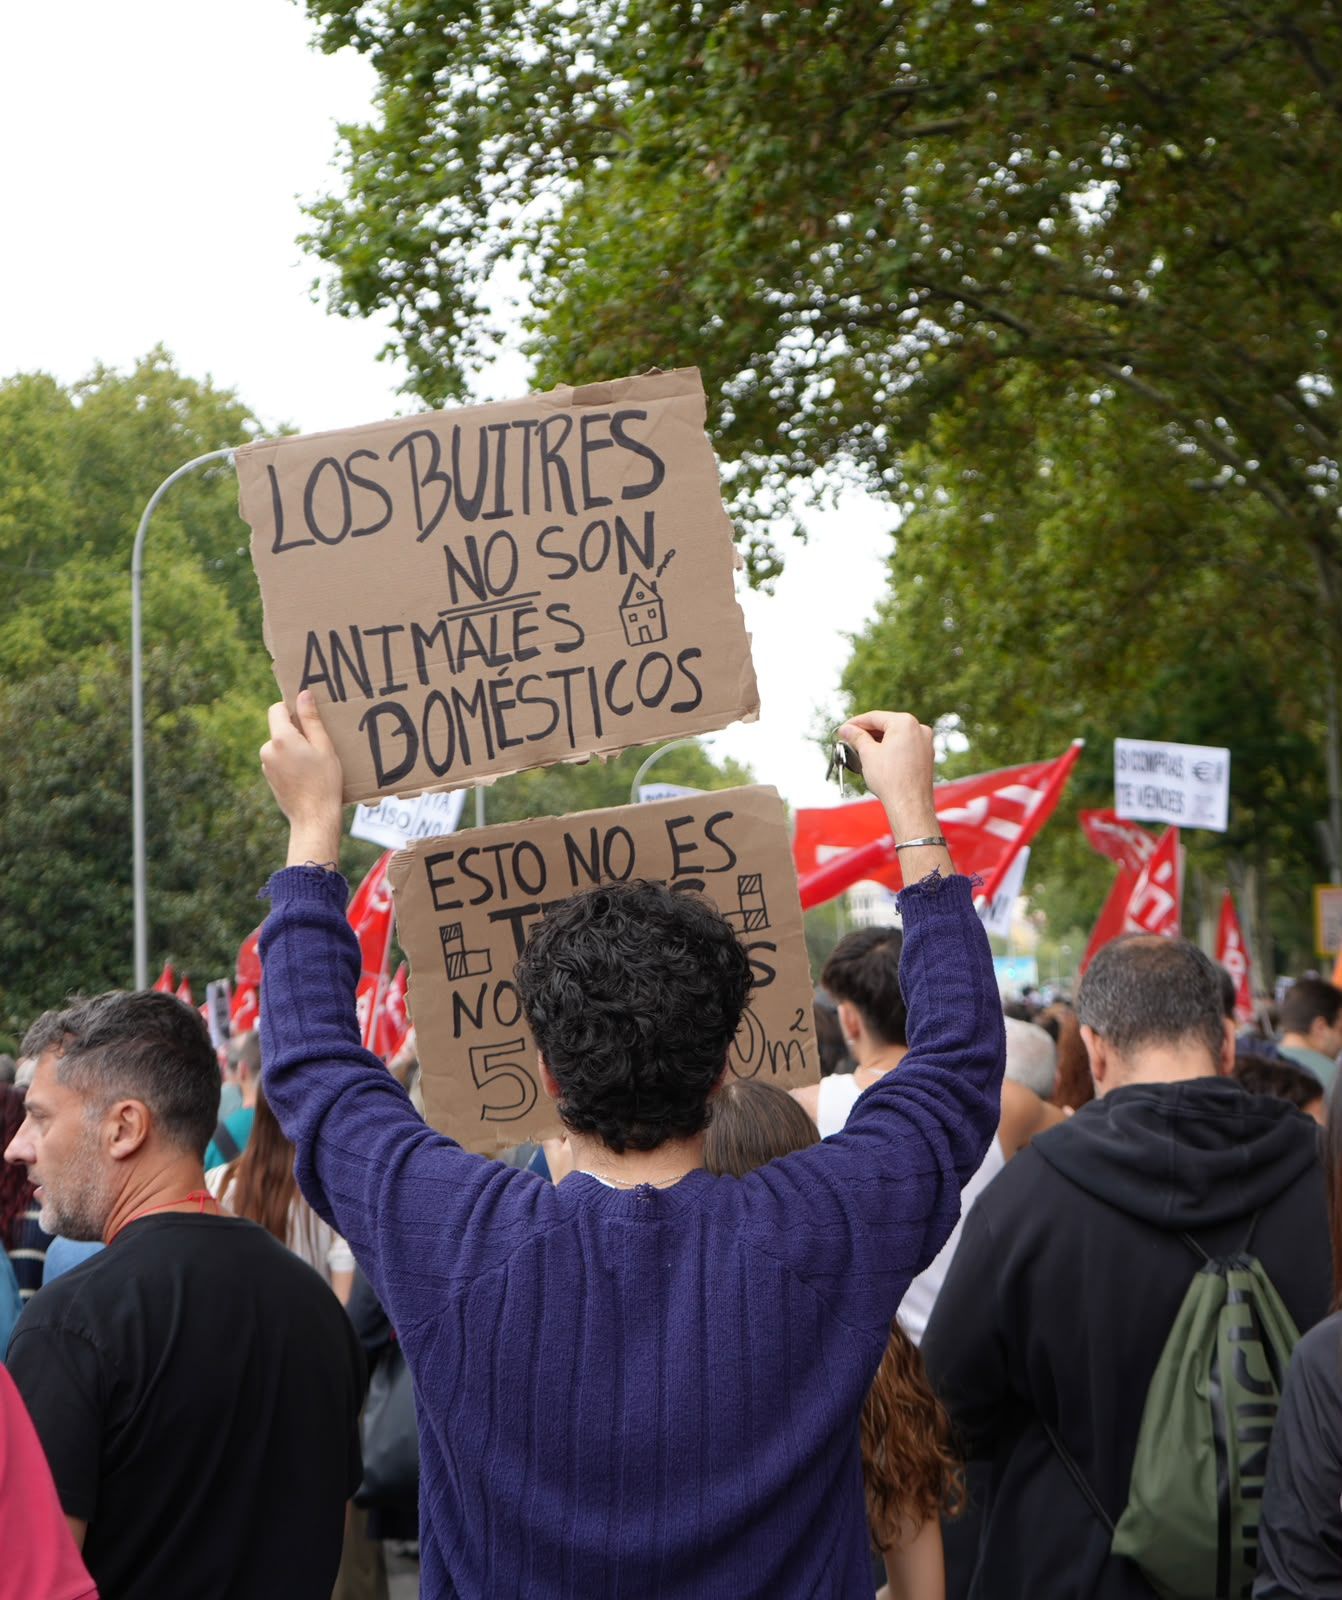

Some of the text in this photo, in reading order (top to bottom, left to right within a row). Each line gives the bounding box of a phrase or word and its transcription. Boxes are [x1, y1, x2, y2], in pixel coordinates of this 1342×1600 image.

[267, 410, 666, 554] LOS BUITRES
[444, 511, 655, 604] NO SON
[300, 603, 585, 702] ANIMALES
[358, 648, 703, 788] DOMÉSTICOS
[424, 841, 547, 912] ESTO
[564, 826, 636, 887] NO
[665, 811, 737, 880] ES
[452, 980, 524, 1039] NO
